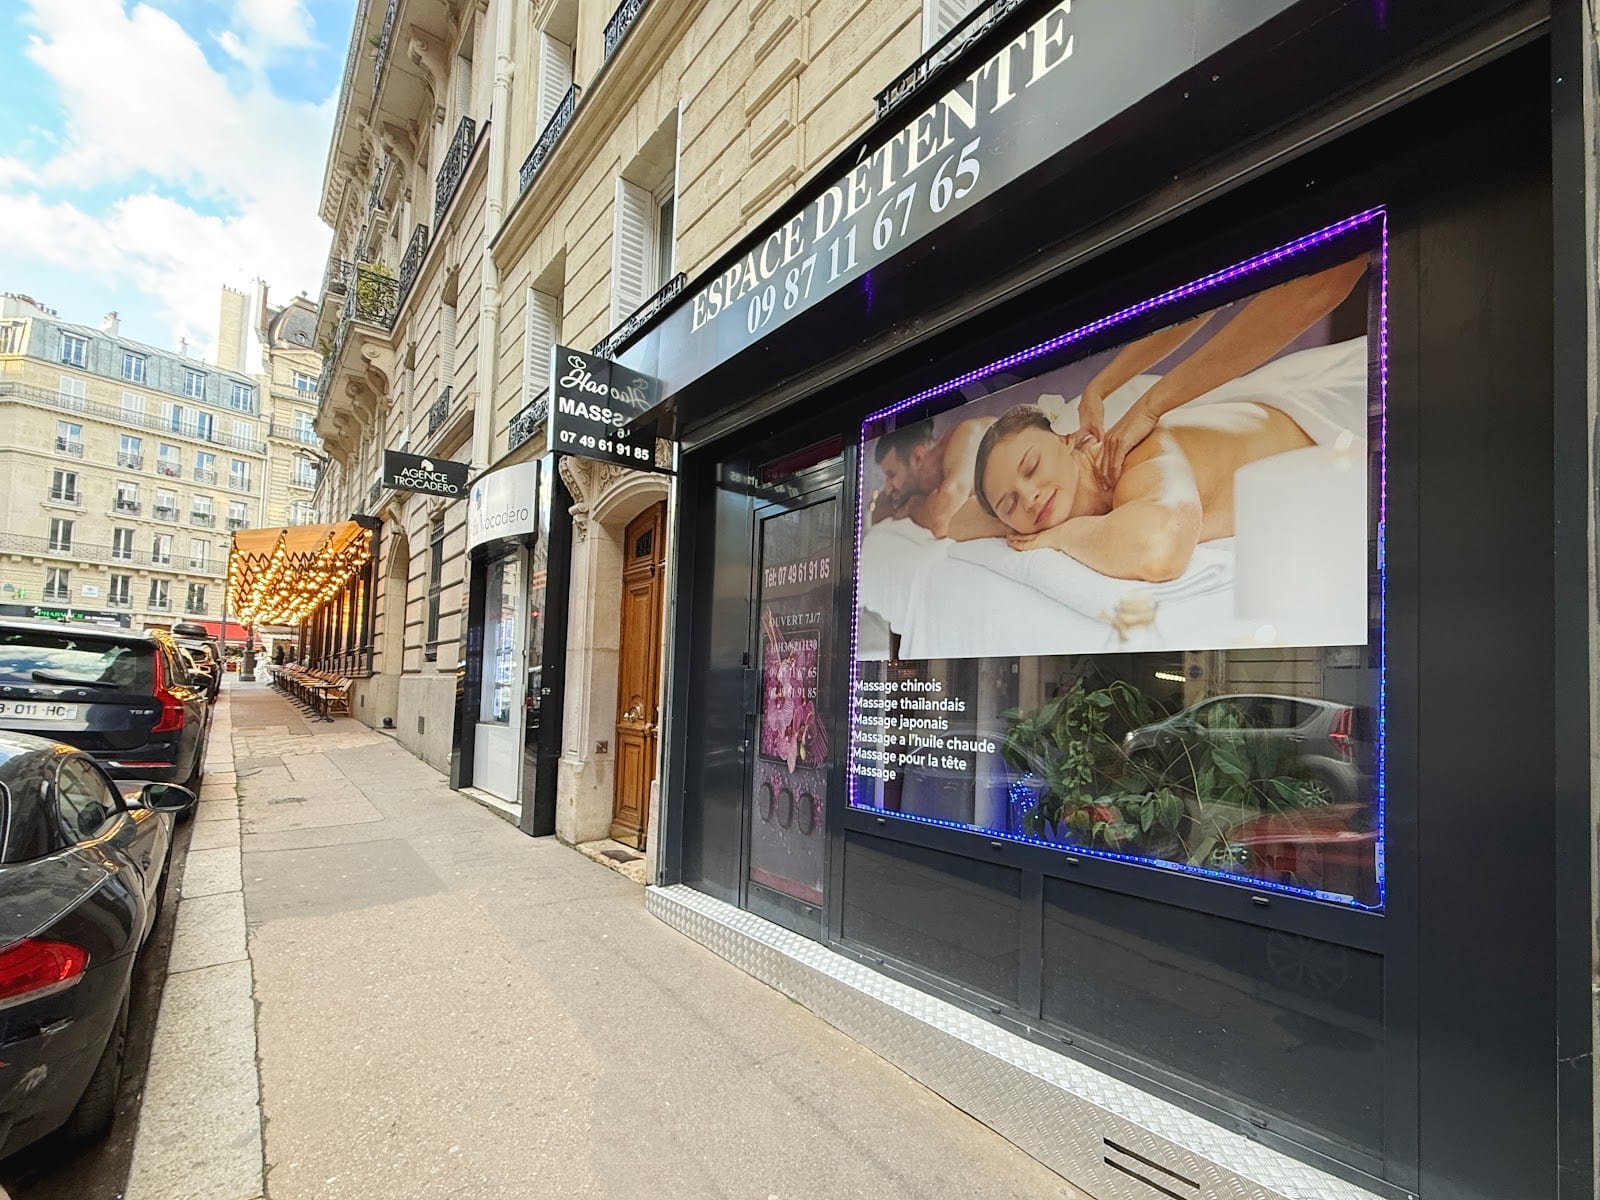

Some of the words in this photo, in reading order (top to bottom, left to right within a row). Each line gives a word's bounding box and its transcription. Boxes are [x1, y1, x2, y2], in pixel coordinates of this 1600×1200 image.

[690, 206, 805, 334] ESPACE
[811, 0, 1075, 244] DÉTENTE
[747, 290, 776, 334] 09
[783, 254, 818, 311] 87
[826, 225, 858, 285] 11
[872, 182, 917, 252] 67
[929, 136, 981, 214] 65
[560, 430, 577, 444] 07
[579, 434, 596, 449] 49
[598, 439, 613, 453] 61
[616, 443, 631, 457] 91
[634, 447, 650, 461] 85
[401, 467, 448, 483] AGENCE
[393, 475, 459, 494] TROCADERO
[778, 566, 787, 586] 07
[787, 563, 797, 584] 49
[798, 562, 807, 583] 61
[808, 560, 818, 581] 91
[820, 558, 830, 579] 85
[37, 609, 85, 619] PHARMCIE
[769, 614, 804, 628] OUVERT
[807, 667, 817, 678] 65
[807, 687, 817, 699] 85
[855, 679, 899, 694] Massage
[900, 678, 942, 692] chinois
[854, 696, 898, 712] Massage
[854, 713, 898, 729] Massage
[898, 713, 949, 731] japonais
[853, 730, 898, 746] Massage
[908, 733, 944, 749] l'huile
[946, 736, 996, 754] chaude
[853, 747, 897, 764] Massage
[898, 752, 926, 766] pour
[928, 753, 939, 767] la
[941, 755, 968, 771] tête
[852, 763, 897, 782] Massage
